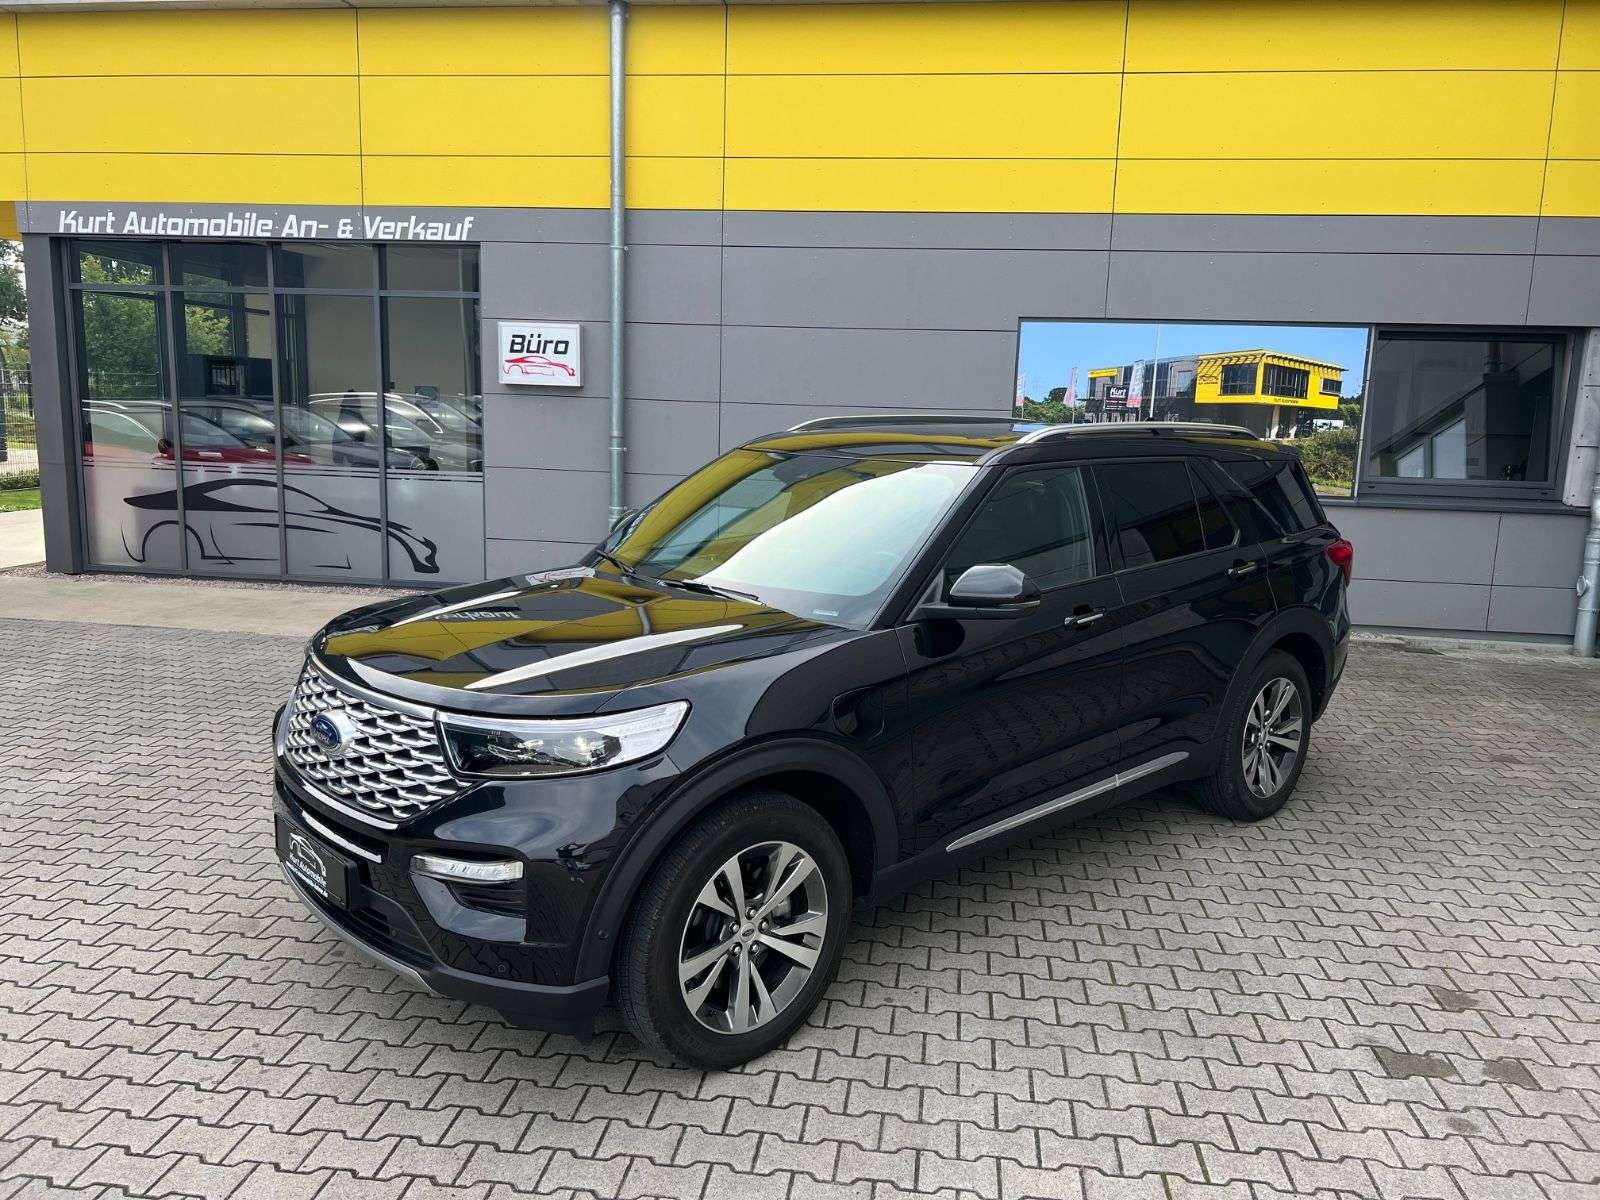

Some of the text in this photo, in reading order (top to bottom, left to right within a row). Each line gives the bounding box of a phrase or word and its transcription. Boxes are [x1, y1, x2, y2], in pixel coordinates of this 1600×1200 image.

[58, 210, 475, 241] Kurt Automobile An- & Verkauf
[509, 333, 570, 355] Büro
